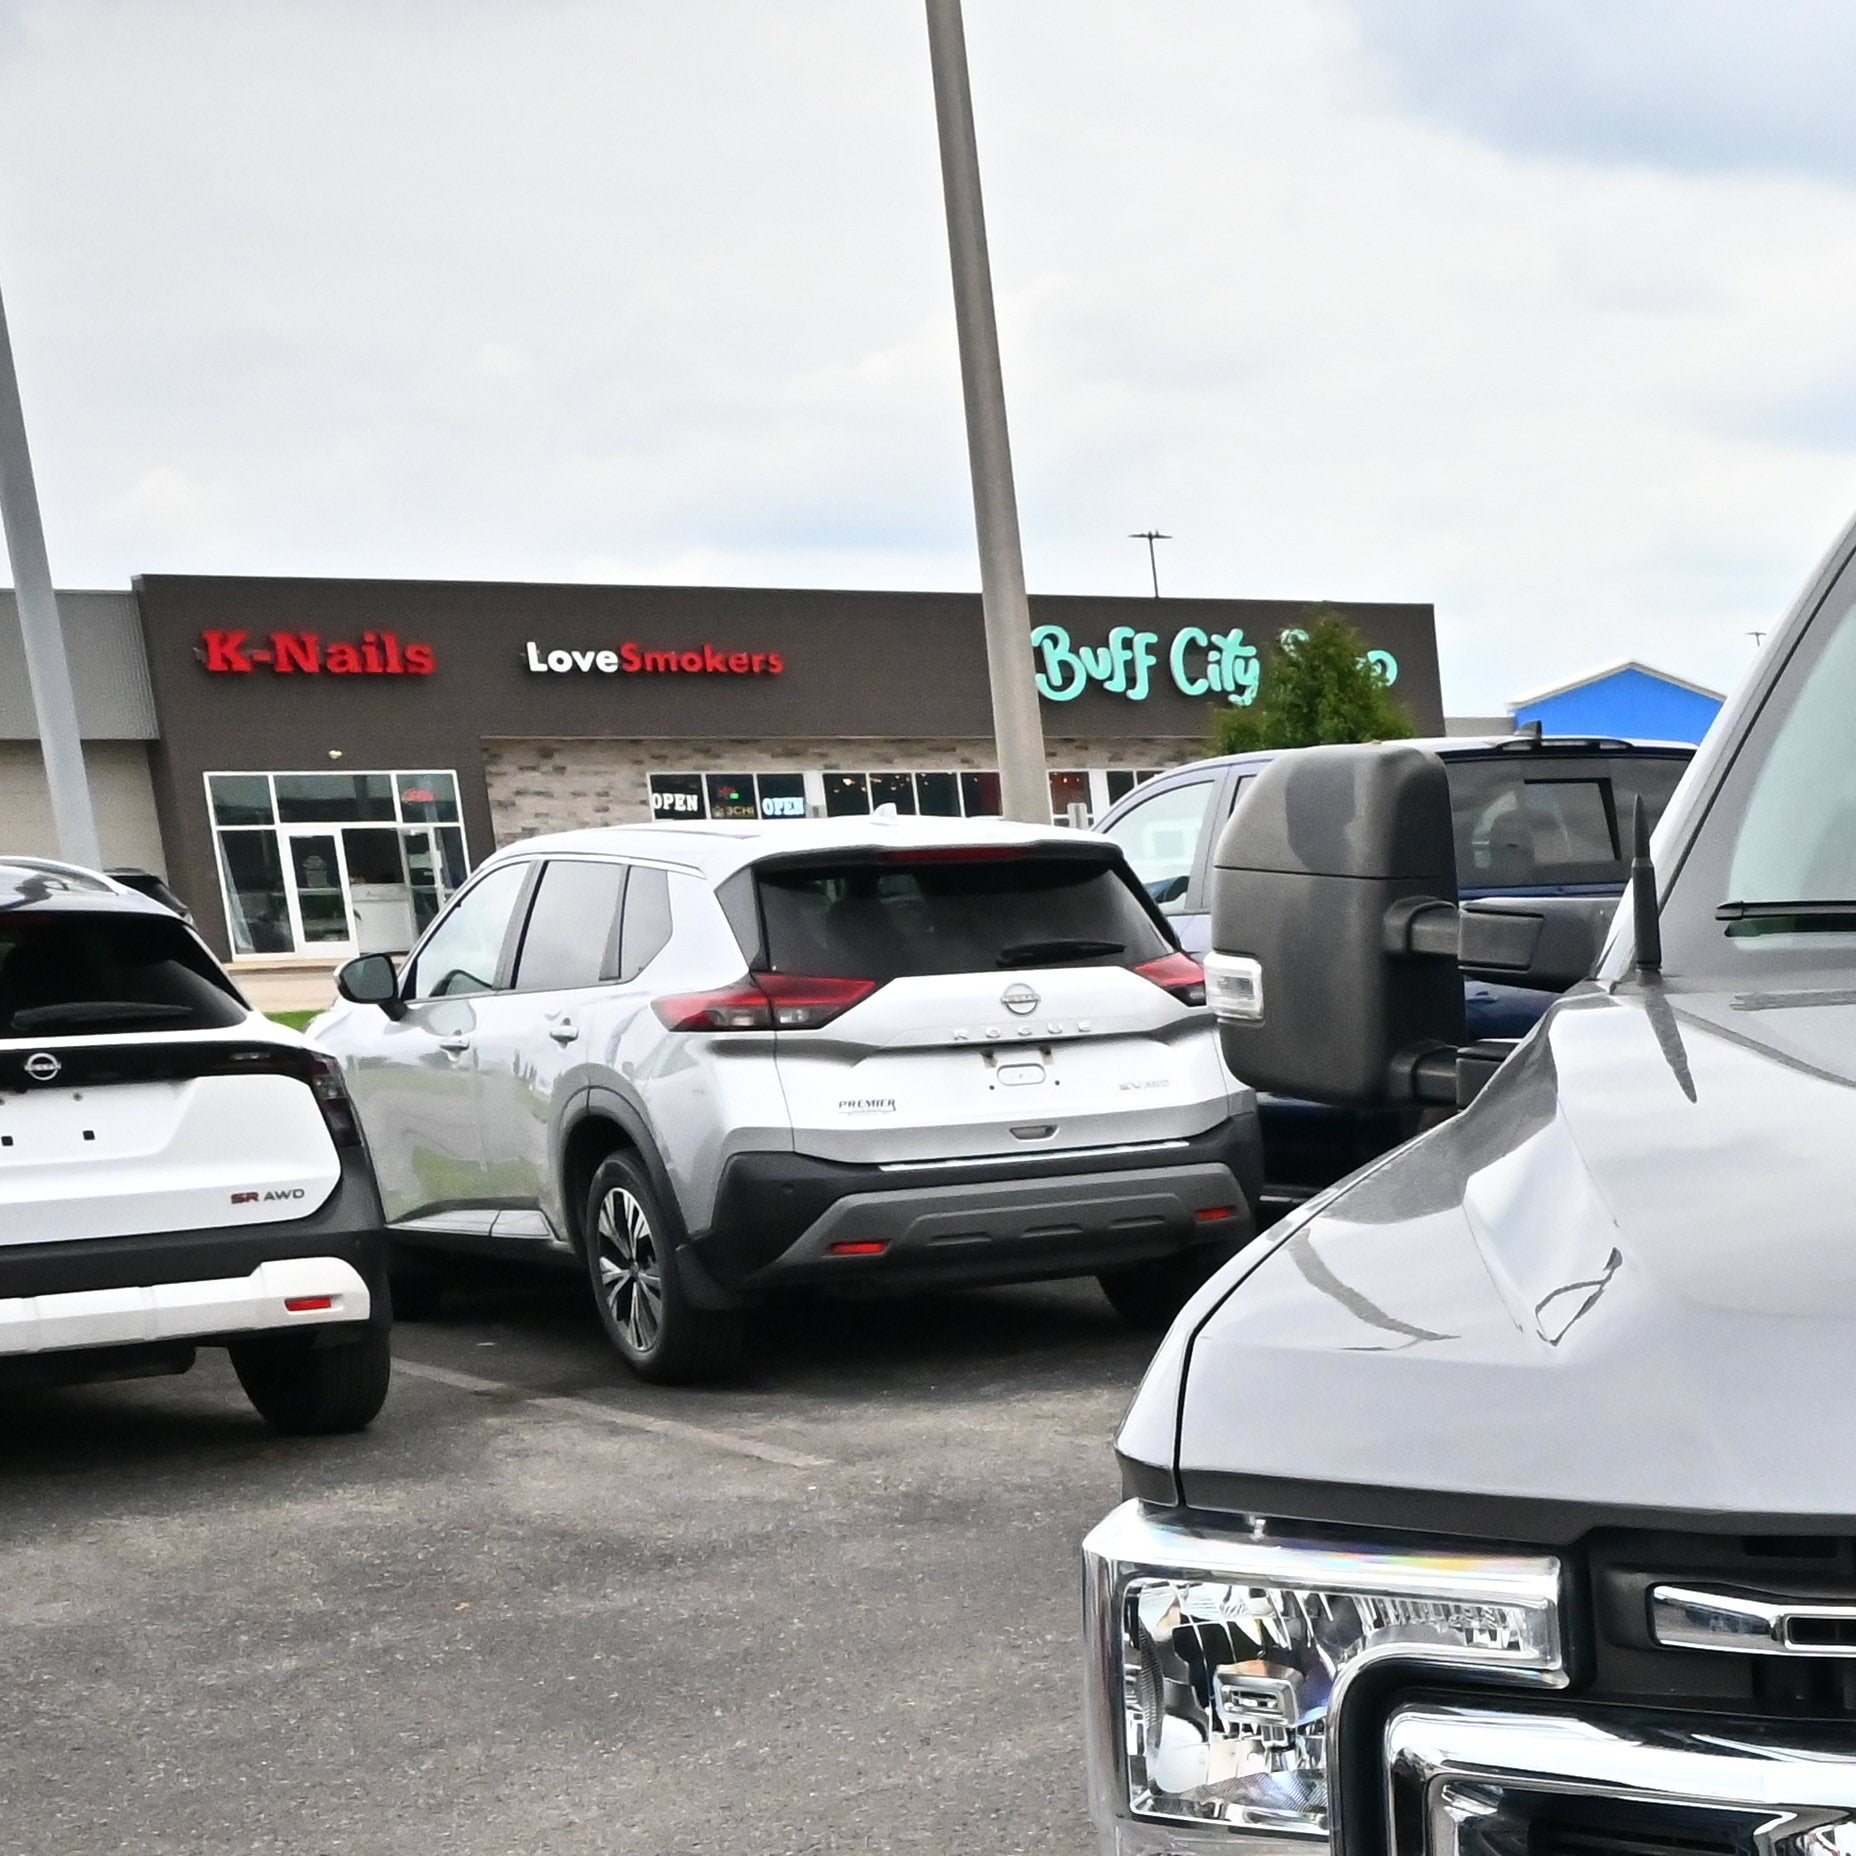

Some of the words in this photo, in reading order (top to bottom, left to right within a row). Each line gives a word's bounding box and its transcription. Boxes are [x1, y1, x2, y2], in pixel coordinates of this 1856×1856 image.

[202, 629, 437, 675] K-Nails
[526, 641, 785, 674] LoveSmokers
[1030, 624, 1159, 702] Buff
[1169, 626, 1261, 707] City
[651, 792, 699, 812] OPEN
[761, 796, 805, 816] OPEN
[953, 1021, 1092, 1041] ROGUE
[838, 1098, 897, 1112] PREMIER
[230, 1191, 259, 1205] SR
[263, 1188, 306, 1202] AWD
